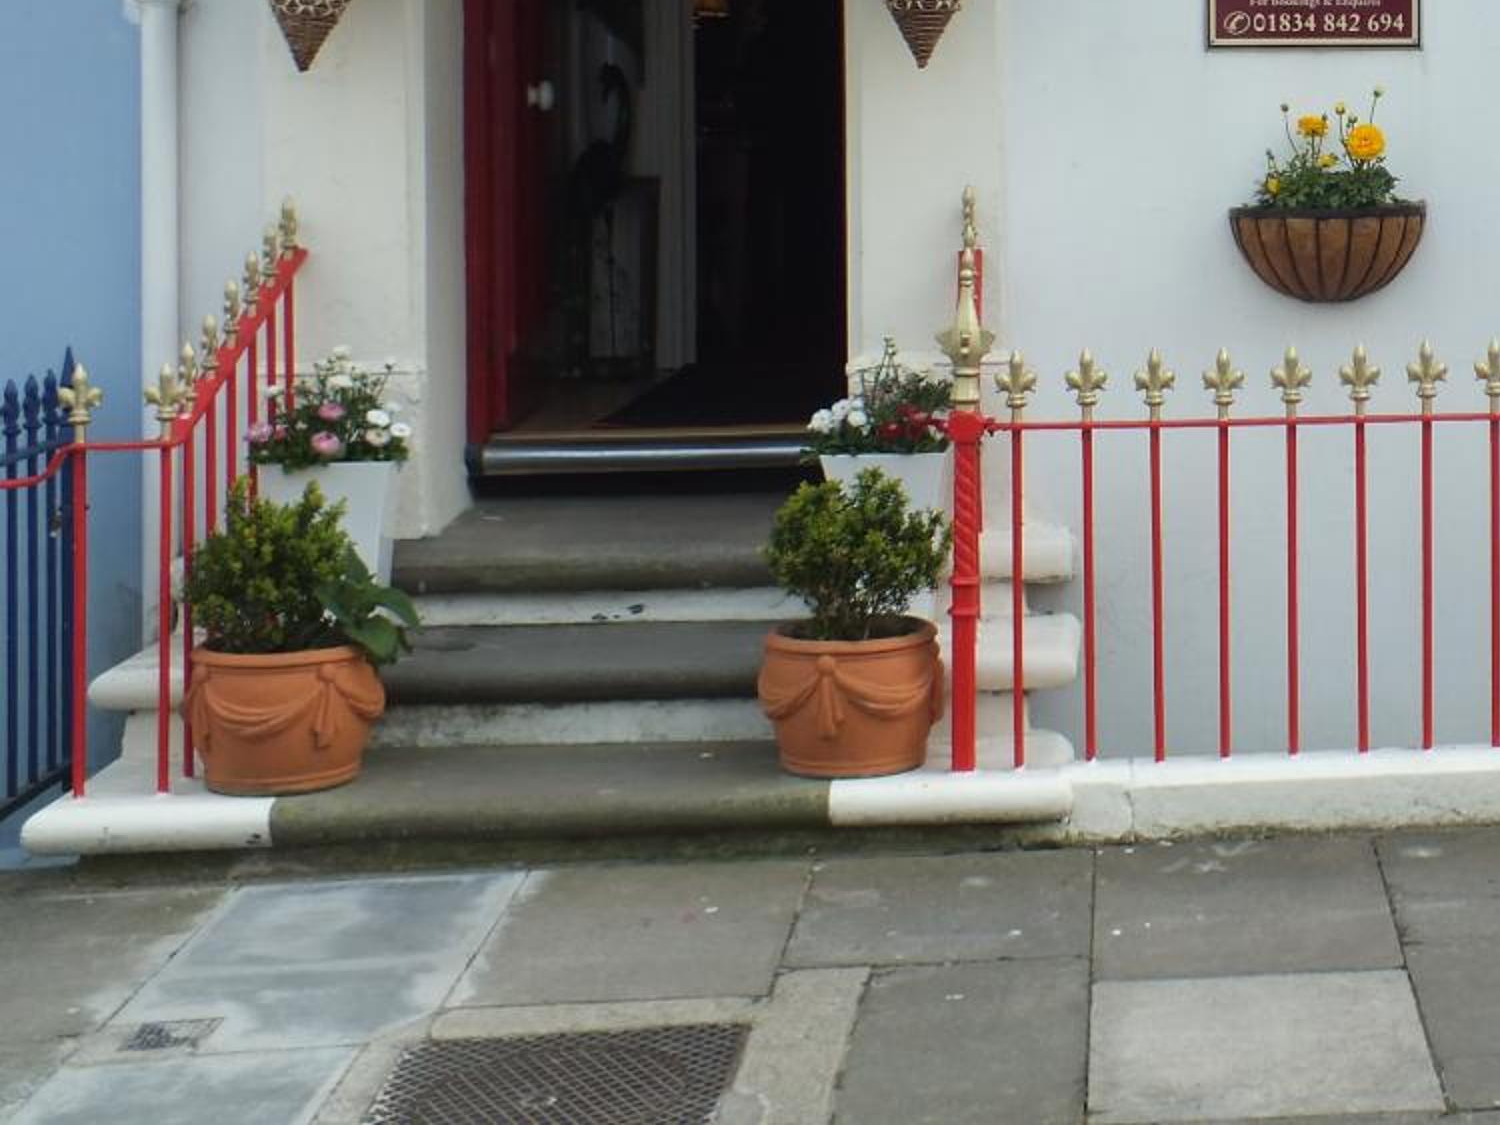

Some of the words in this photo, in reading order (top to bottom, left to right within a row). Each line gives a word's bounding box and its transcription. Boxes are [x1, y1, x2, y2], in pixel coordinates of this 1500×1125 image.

[1253, 13, 1316, 32] 01834
[1324, 13, 1361, 32] 842
[1367, 13, 1405, 32] 694
